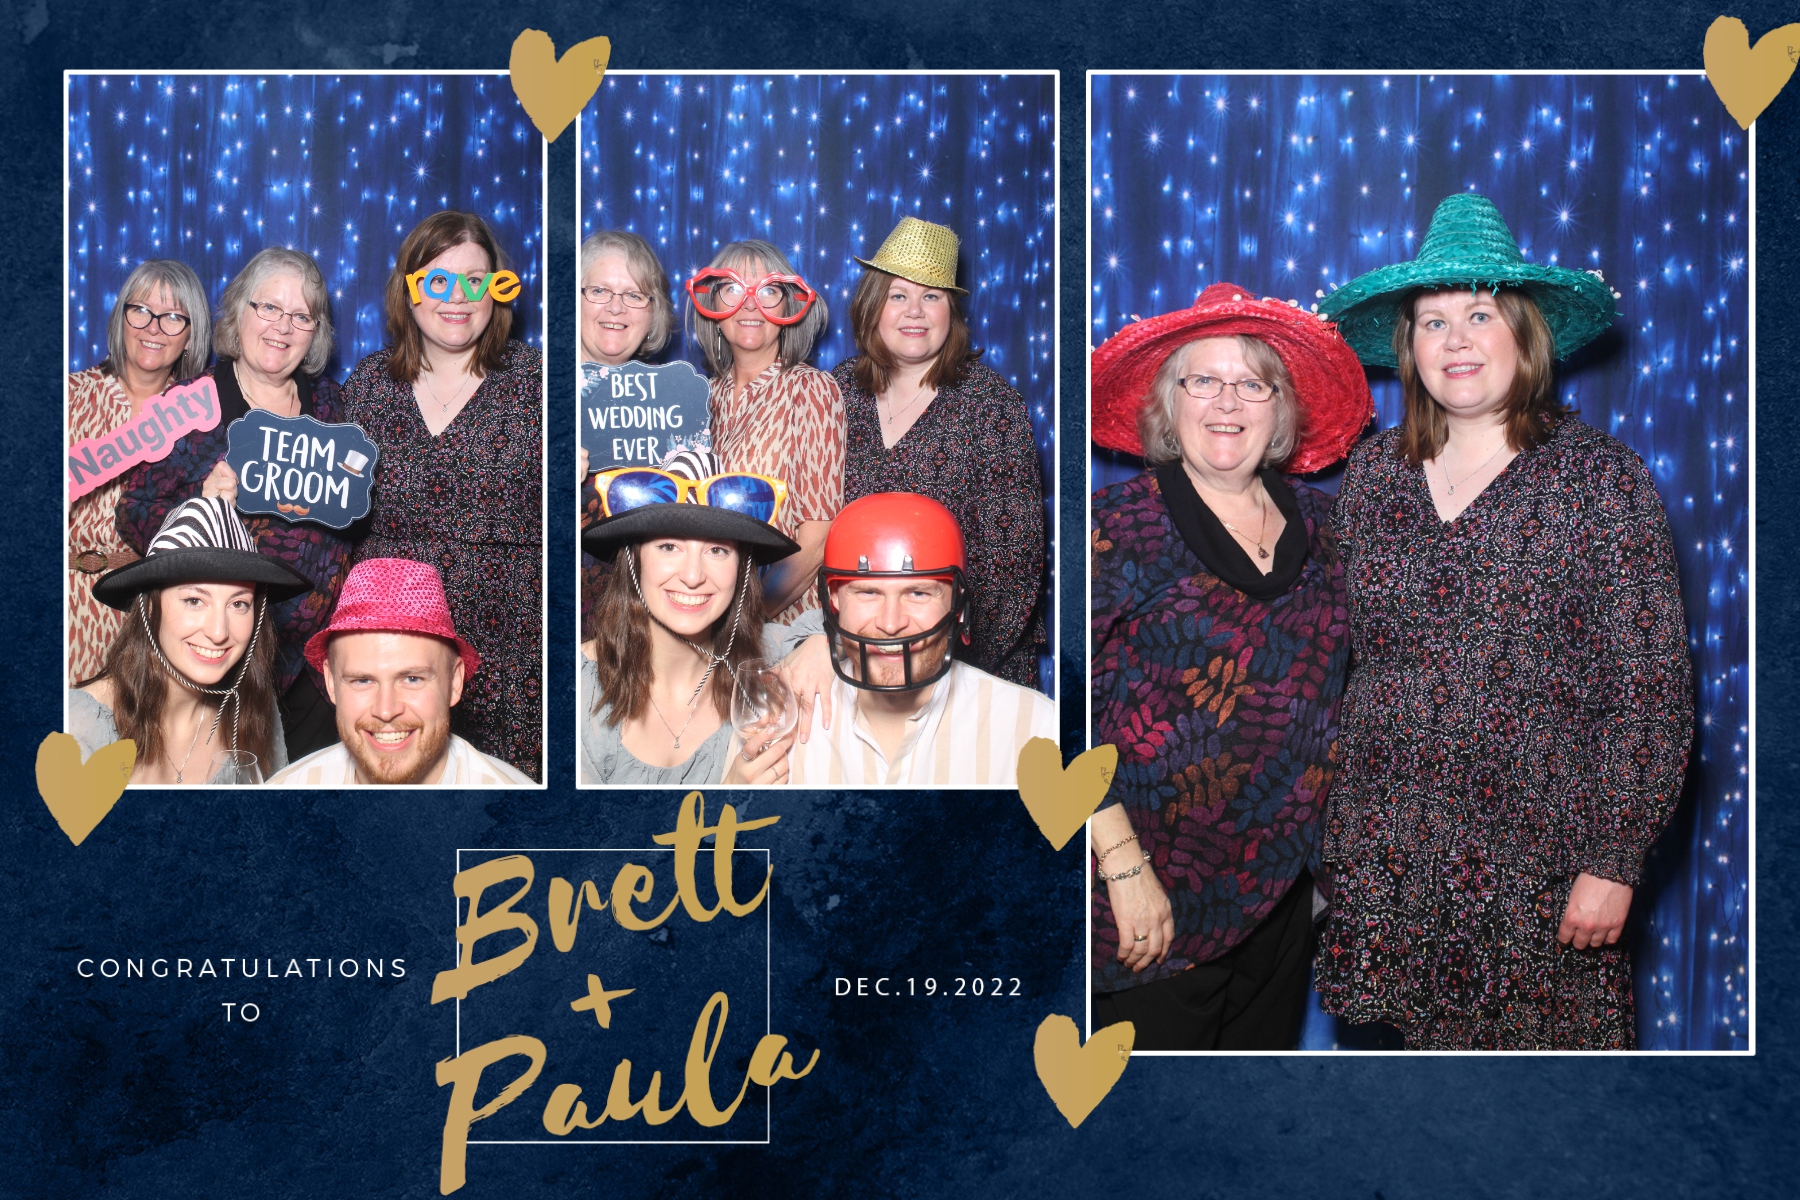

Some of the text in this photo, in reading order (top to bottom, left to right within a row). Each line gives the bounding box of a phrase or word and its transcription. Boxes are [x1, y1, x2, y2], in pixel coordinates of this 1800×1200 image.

[405, 268, 521, 305] rave
[611, 372, 658, 402] BEST
[69, 385, 214, 486] Naughty
[588, 404, 683, 431] WEDDING
[259, 426, 336, 472] TEAM
[612, 436, 663, 466] EVER
[240, 460, 350, 509] GROOM
